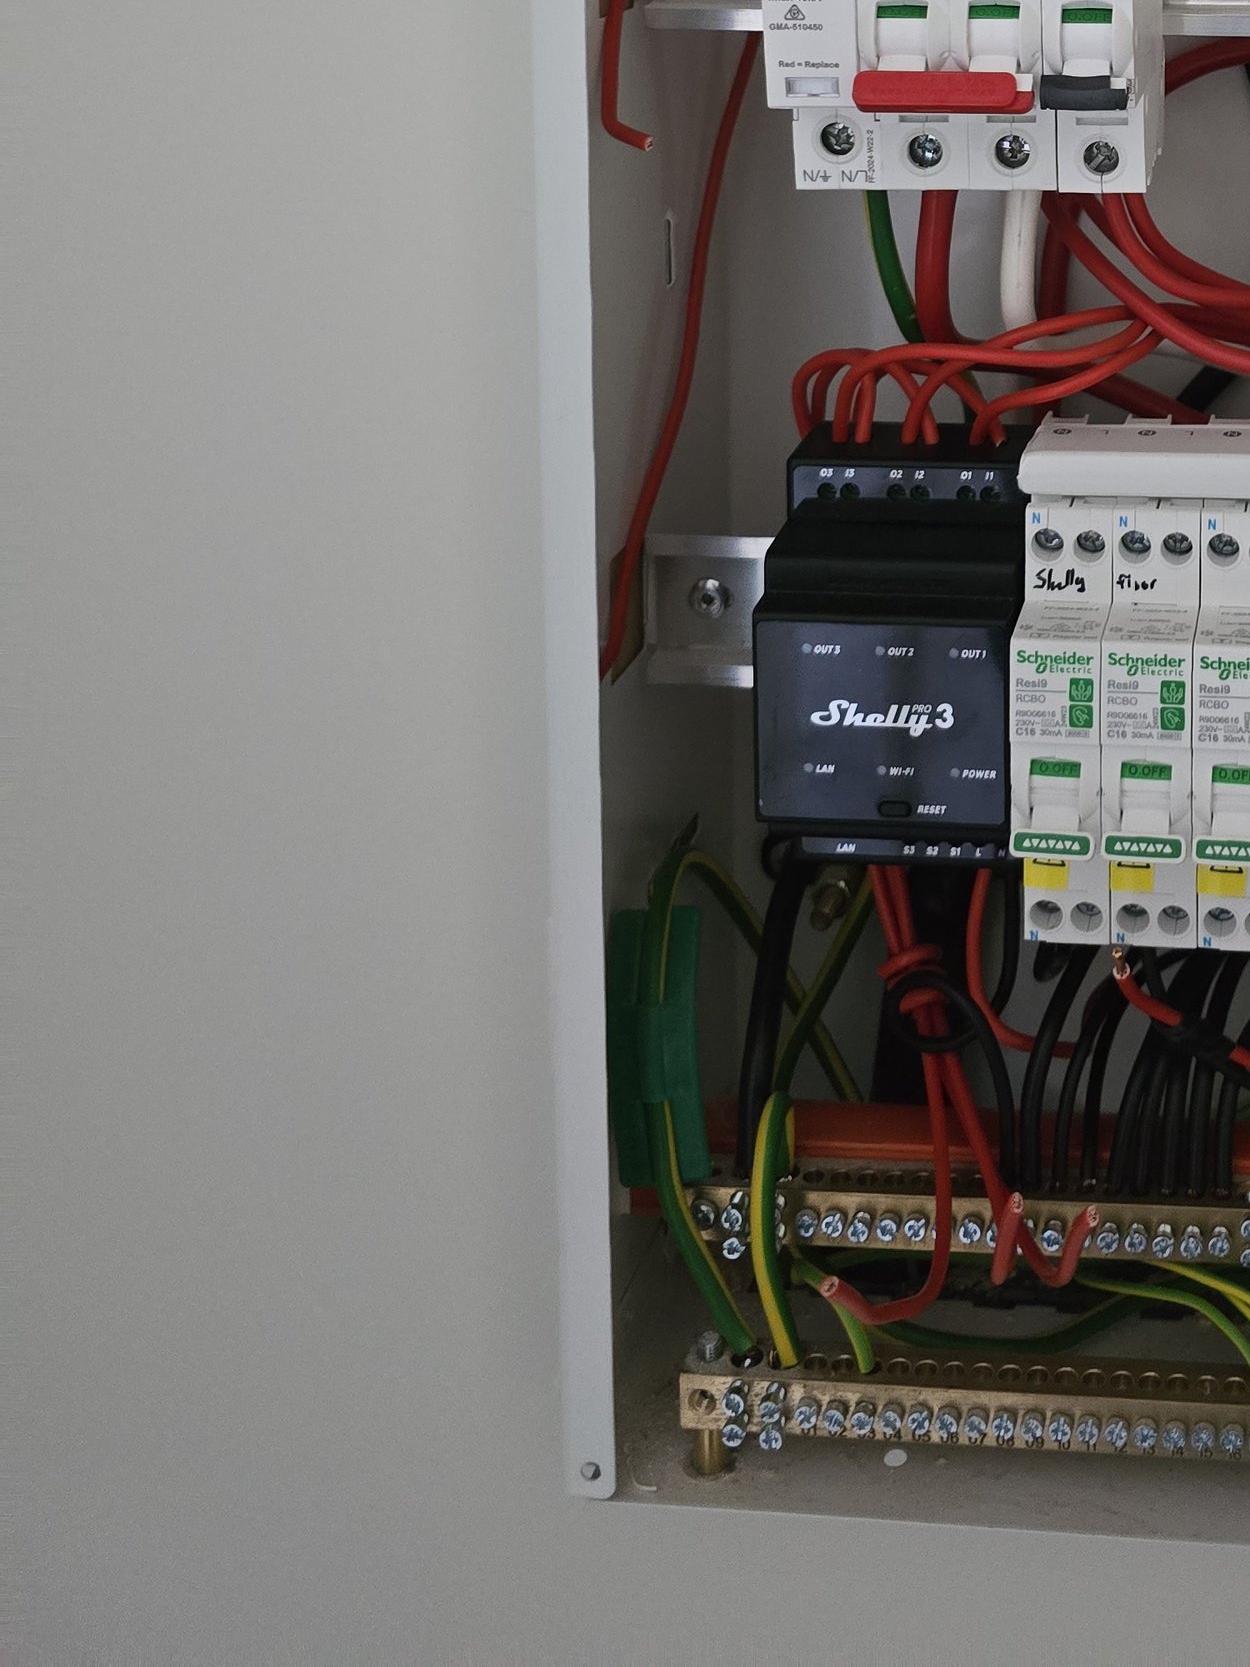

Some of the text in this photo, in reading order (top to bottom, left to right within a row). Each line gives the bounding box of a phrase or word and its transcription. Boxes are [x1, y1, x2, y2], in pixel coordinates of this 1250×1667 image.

[805, 61, 840, 69] Replace
[1032, 512, 1040, 524] N
[1120, 516, 1128, 527] N
[1017, 650, 1094, 666] Schneider
[1108, 653, 1186, 668] Schneider
[1050, 666, 1092, 674] Electric
[1016, 694, 1046, 703] RCBO
[1107, 696, 1138, 706] RCBO
[1199, 700, 1229, 710] RCBO
[810, 699, 954, 738] Shelly PRO 3
[815, 764, 835, 773] LAN
[962, 770, 997, 779] POWER
[917, 805, 947, 814] RESET
[836, 843, 856, 853] LAN
